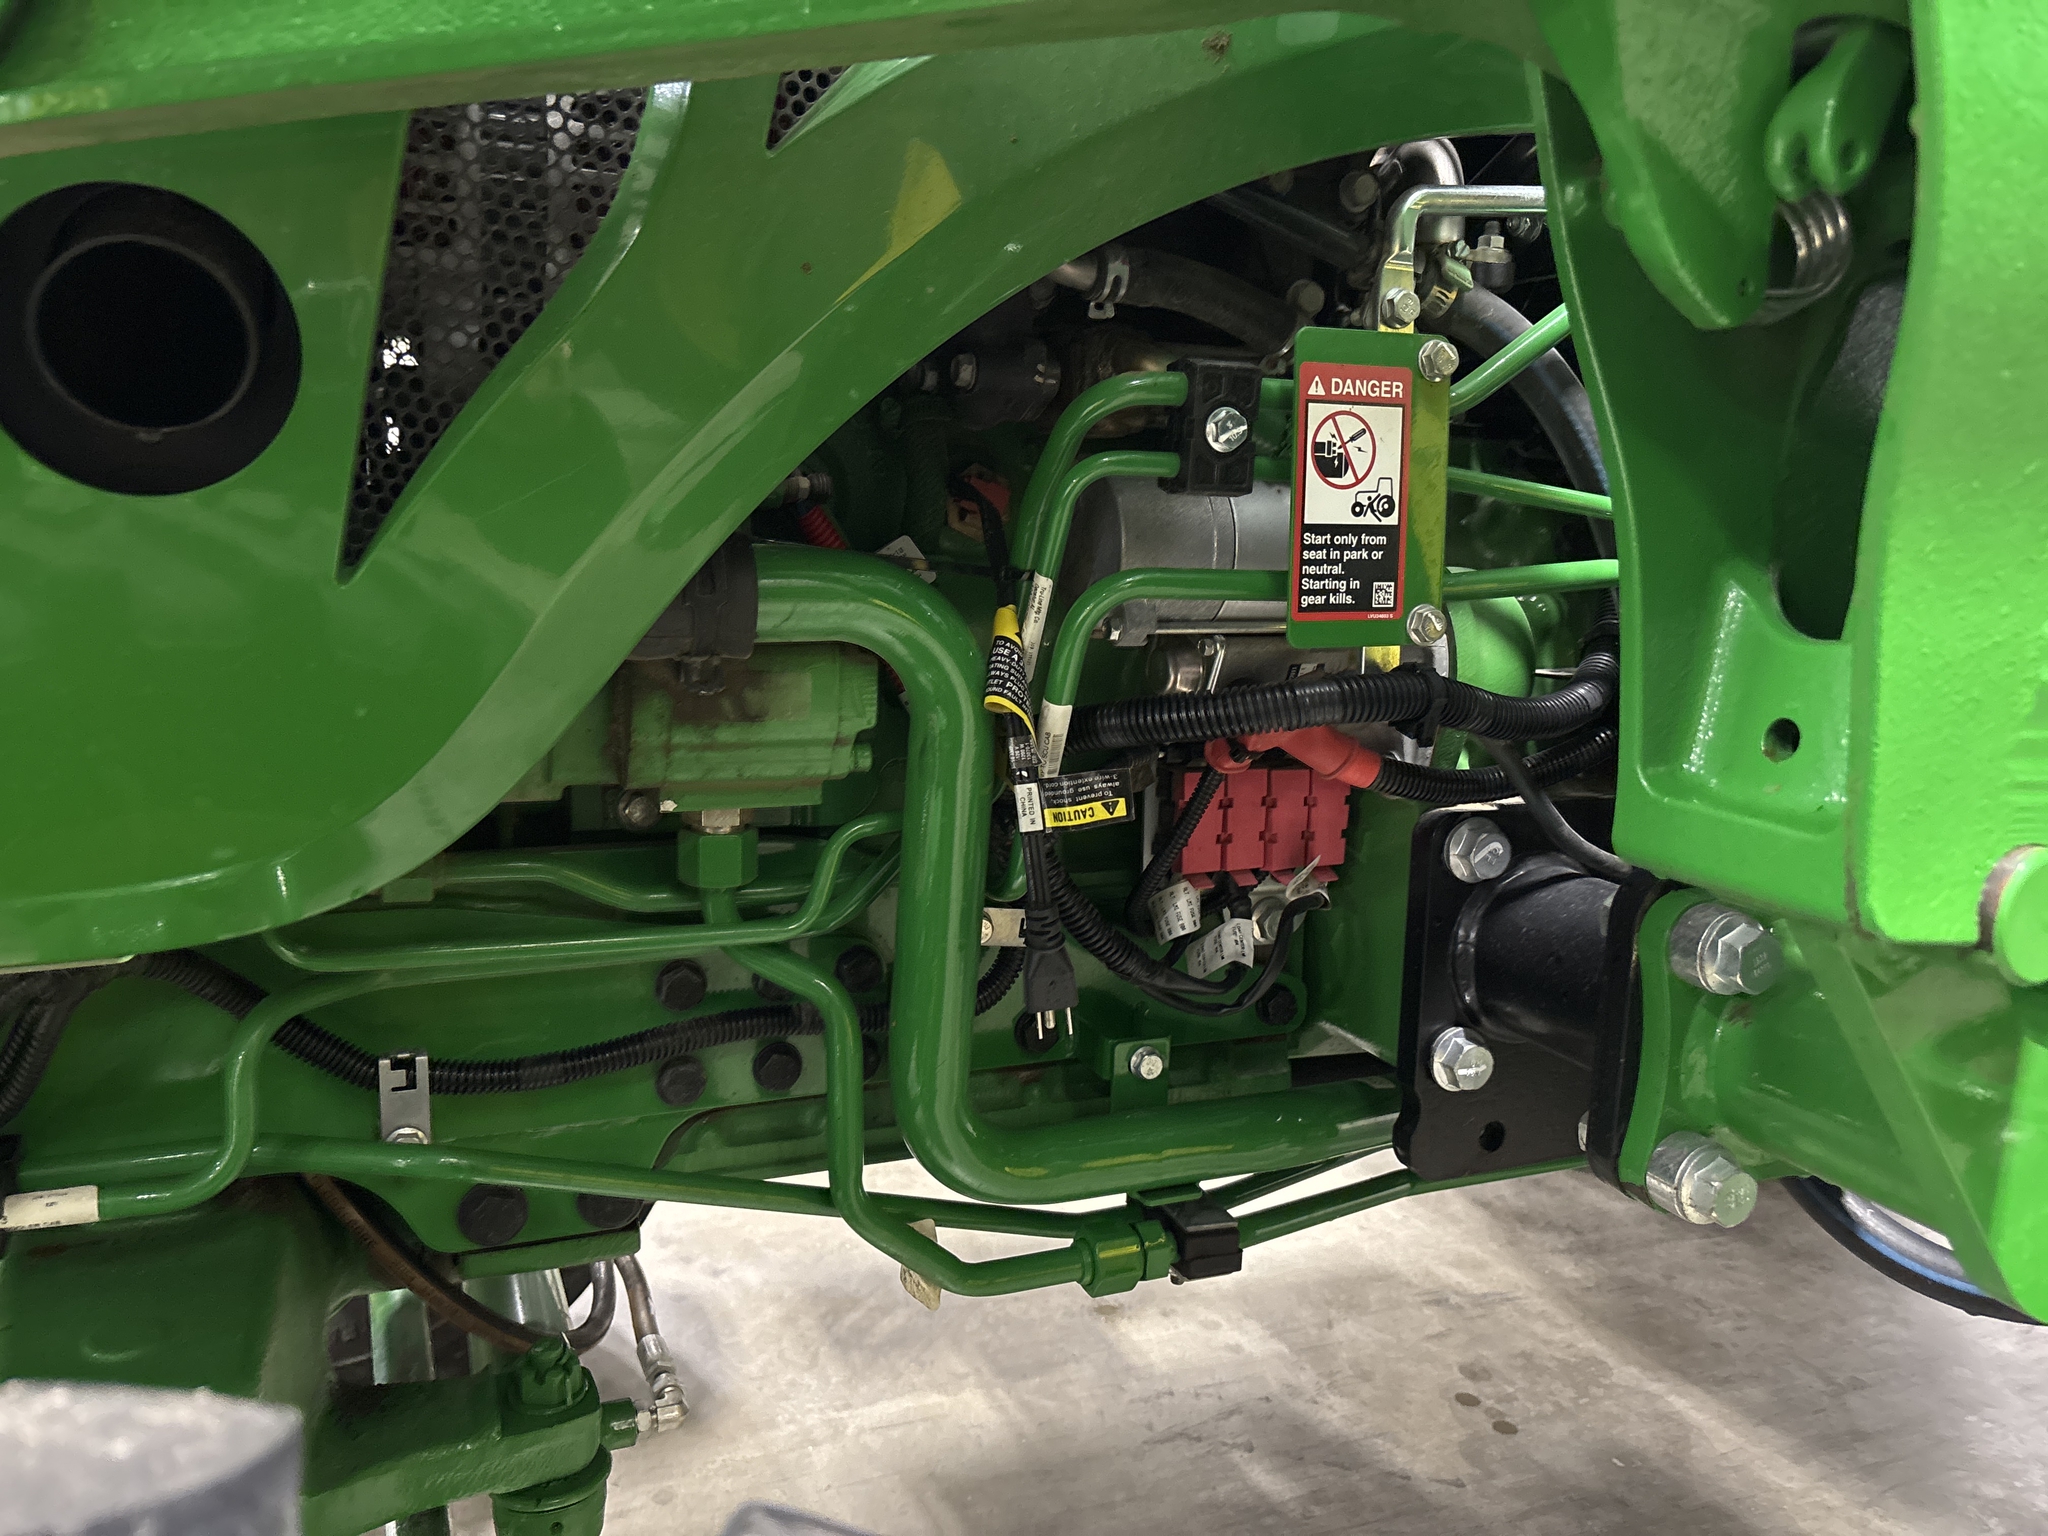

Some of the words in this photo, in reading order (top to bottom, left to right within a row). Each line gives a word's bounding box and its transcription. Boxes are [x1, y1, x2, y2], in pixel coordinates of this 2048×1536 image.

[1330, 378, 1404, 398] DANGER
[1303, 532, 1332, 545] Start
[1334, 534, 1359, 547] only
[1361, 534, 1387, 546] from
[1302, 548, 1327, 560] seat
[1329, 549, 1340, 560] in
[1343, 549, 1368, 562] park
[1371, 551, 1383, 560] or
[1302, 563, 1345, 575] neutral.
[1301, 578, 1346, 593] Starting
[1348, 579, 1360, 590] in
[1300, 595, 1324, 607] gear
[1327, 593, 1356, 604] kills.
[992, 647, 1011, 656] USE
[1003, 689, 1022, 704] FAULT
[1043, 731, 1051, 745] CAB
[1041, 746, 1049, 759] SCU
[1094, 781, 1120, 789] always
[1044, 788, 1074, 797] grounded
[1076, 789, 1102, 802] prevent
[1026, 787, 1035, 816] PRINTED
[1052, 807, 1094, 822] CAUTION
